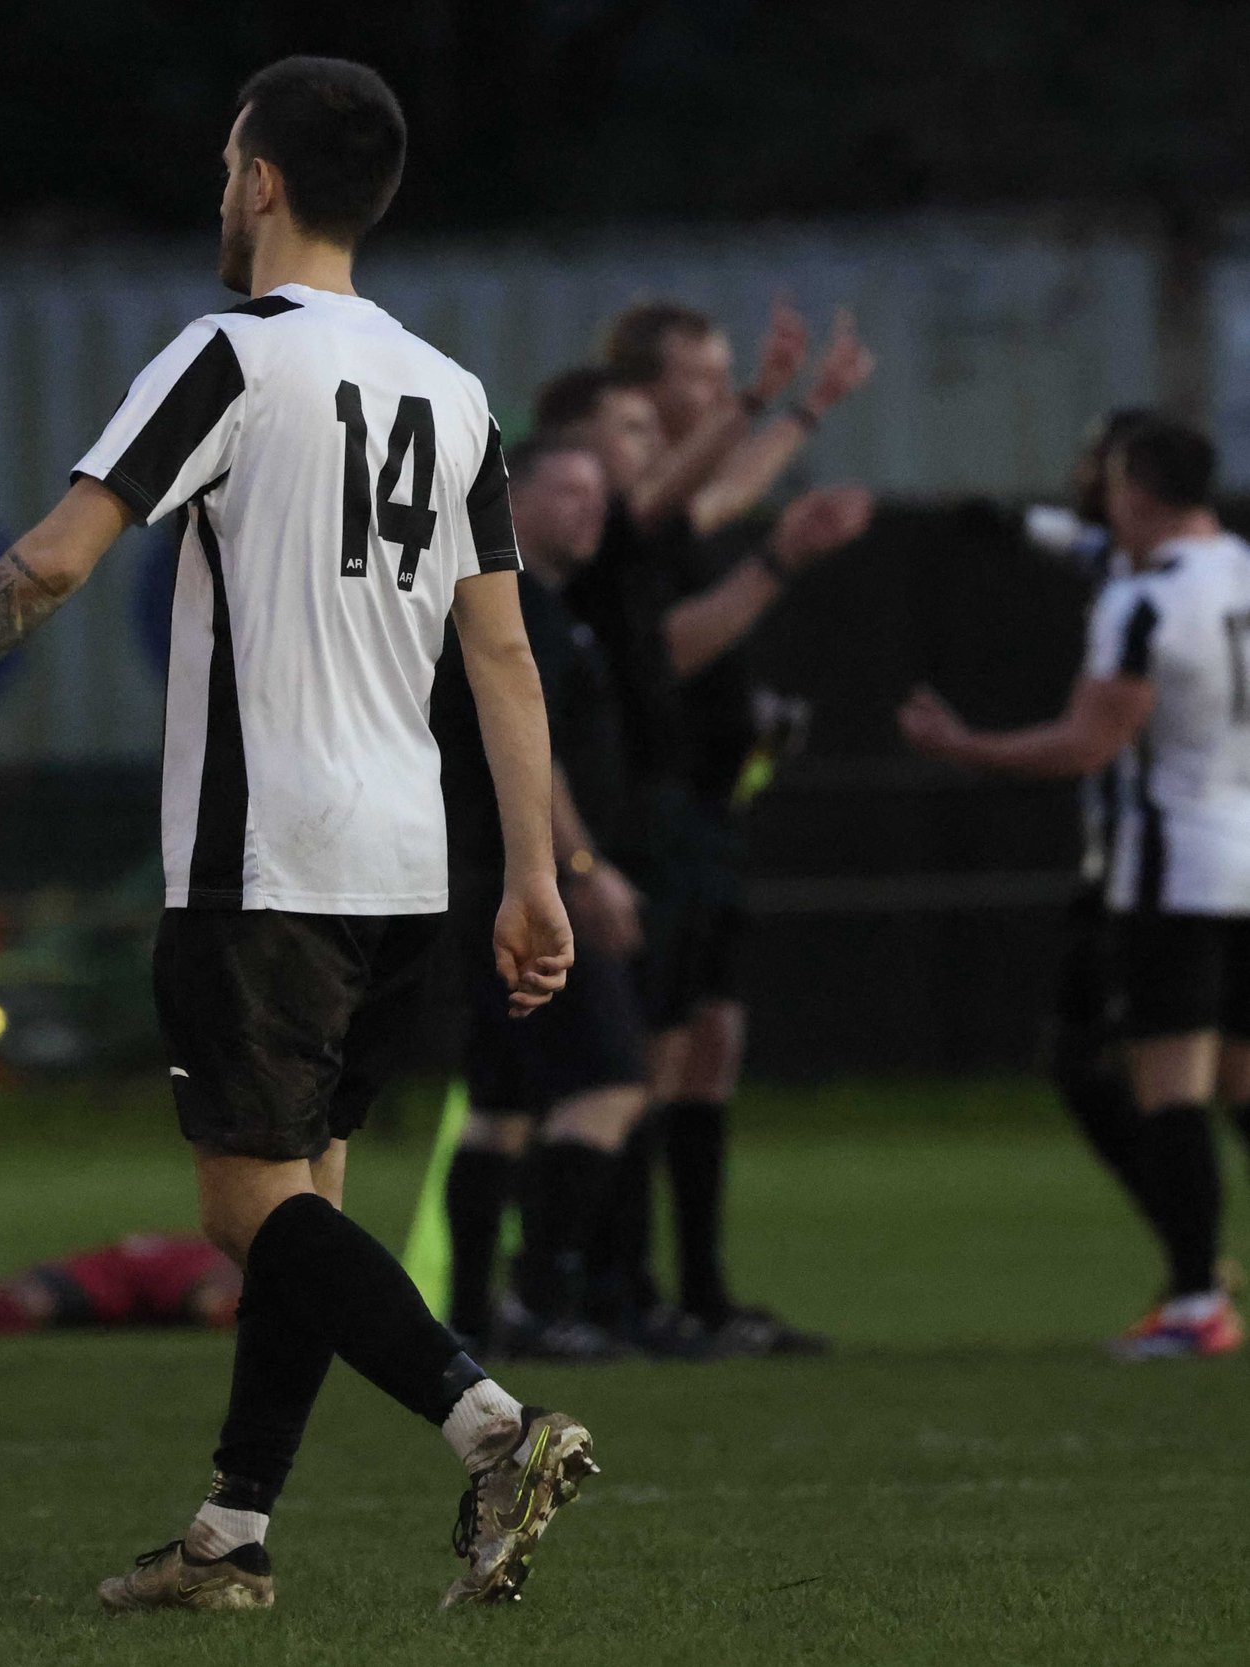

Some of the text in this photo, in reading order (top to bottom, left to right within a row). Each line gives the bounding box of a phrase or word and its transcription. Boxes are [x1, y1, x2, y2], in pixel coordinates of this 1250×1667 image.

[335, 379, 438, 592] 14
[346, 557, 363, 569] AR
[399, 571, 413, 583] AR
